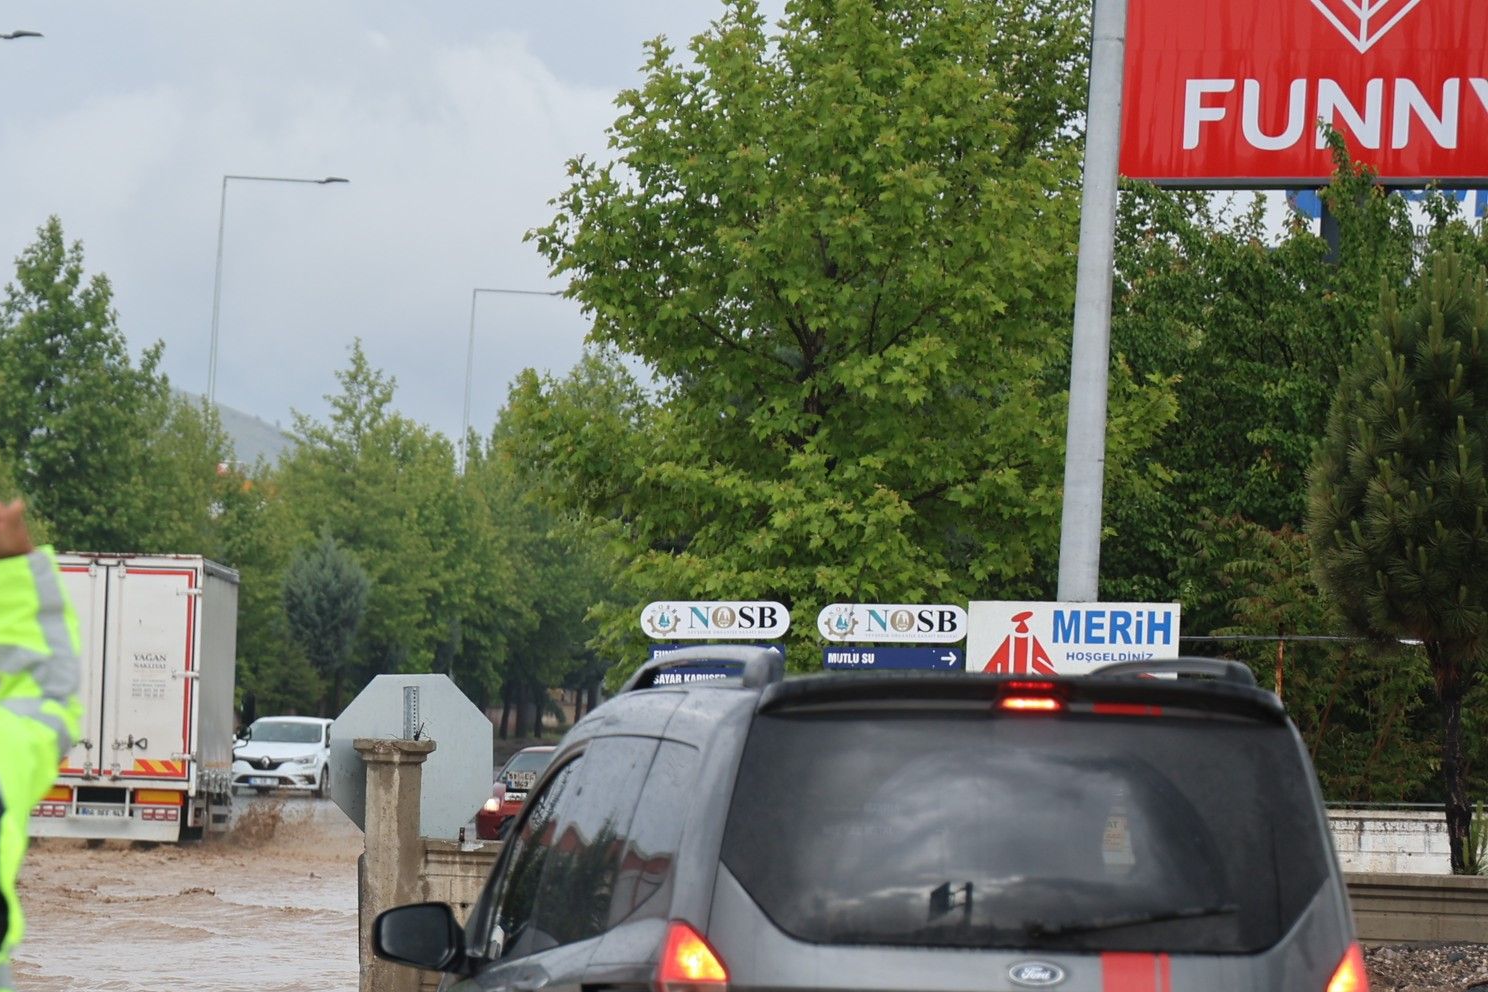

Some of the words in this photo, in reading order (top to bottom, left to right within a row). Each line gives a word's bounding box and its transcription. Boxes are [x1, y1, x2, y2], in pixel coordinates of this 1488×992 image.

[687, 605, 778, 629] NOSB
[865, 608, 958, 633] NOSB
[827, 652, 859, 664] MUTLU
[861, 652, 875, 664] SU
